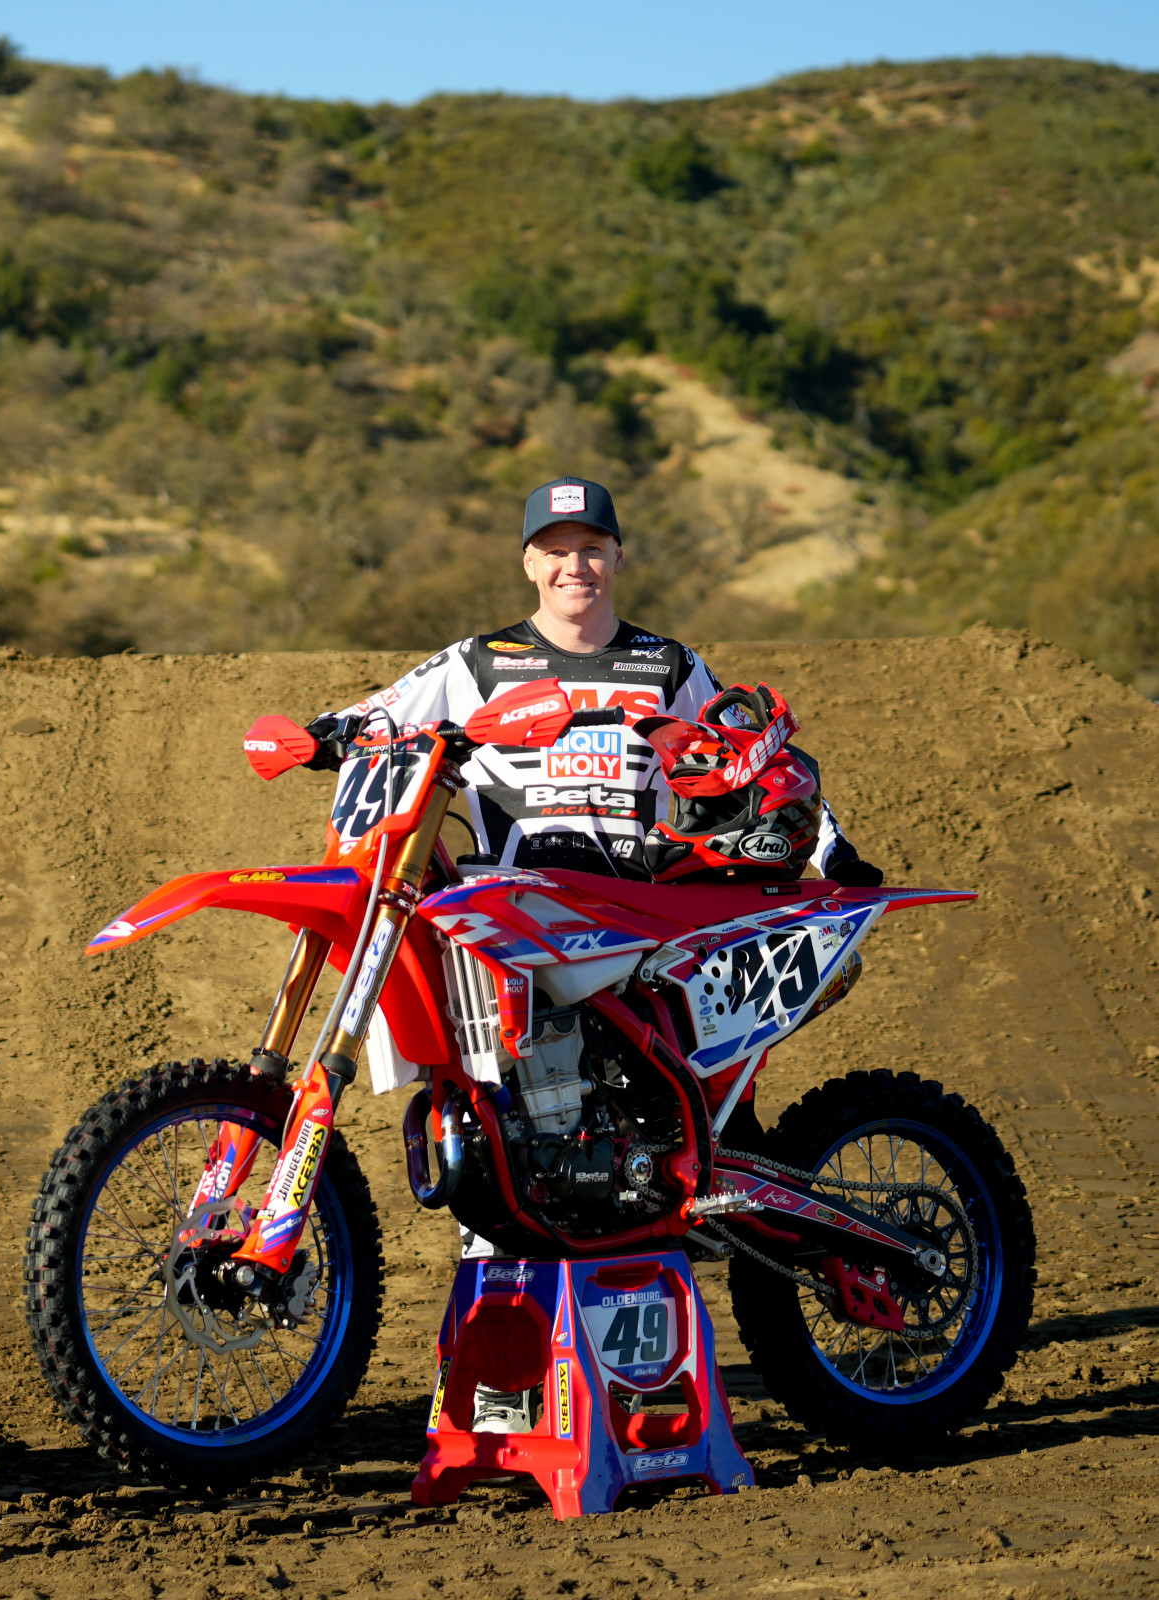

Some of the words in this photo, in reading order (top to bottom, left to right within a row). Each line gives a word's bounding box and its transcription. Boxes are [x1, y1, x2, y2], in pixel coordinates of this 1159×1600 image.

[630, 635, 665, 643] AMA
[492, 656, 549, 667] Beta
[631, 646, 667, 660] SMX
[613, 662, 670, 674] BRIDGESTONE
[499, 699, 561, 726] ACERBIS
[723, 714, 791, 790] 100%
[551, 757, 620, 777] MOLY
[332, 753, 421, 838] 49
[525, 786, 636, 808] Beta
[540, 806, 609, 816] RACING
[609, 838, 636, 859] 49
[744, 836, 785, 854] Arai
[229, 870, 287, 883] FMF
[818, 923, 838, 940] AMA
[340, 918, 396, 1036] Beta
[504, 978, 525, 986] LIQUI
[728, 925, 820, 1023] 49
[504, 985, 525, 993] MOLY
[277, 1119, 314, 1202] BRIDGESTONE
[293, 1126, 327, 1208] ACERBIS
[575, 1171, 609, 1179] Beta
[764, 1190, 792, 1205] Kite
[261, 1214, 303, 1240] Beta
[485, 1266, 535, 1282] Beta
[601, 1291, 661, 1308] OLDENBURG
[601, 1302, 668, 1366] 49
[634, 1366, 659, 1377] Beta
[558, 1364, 570, 1434] ACERBIS
[633, 1450, 689, 1472] Beta
